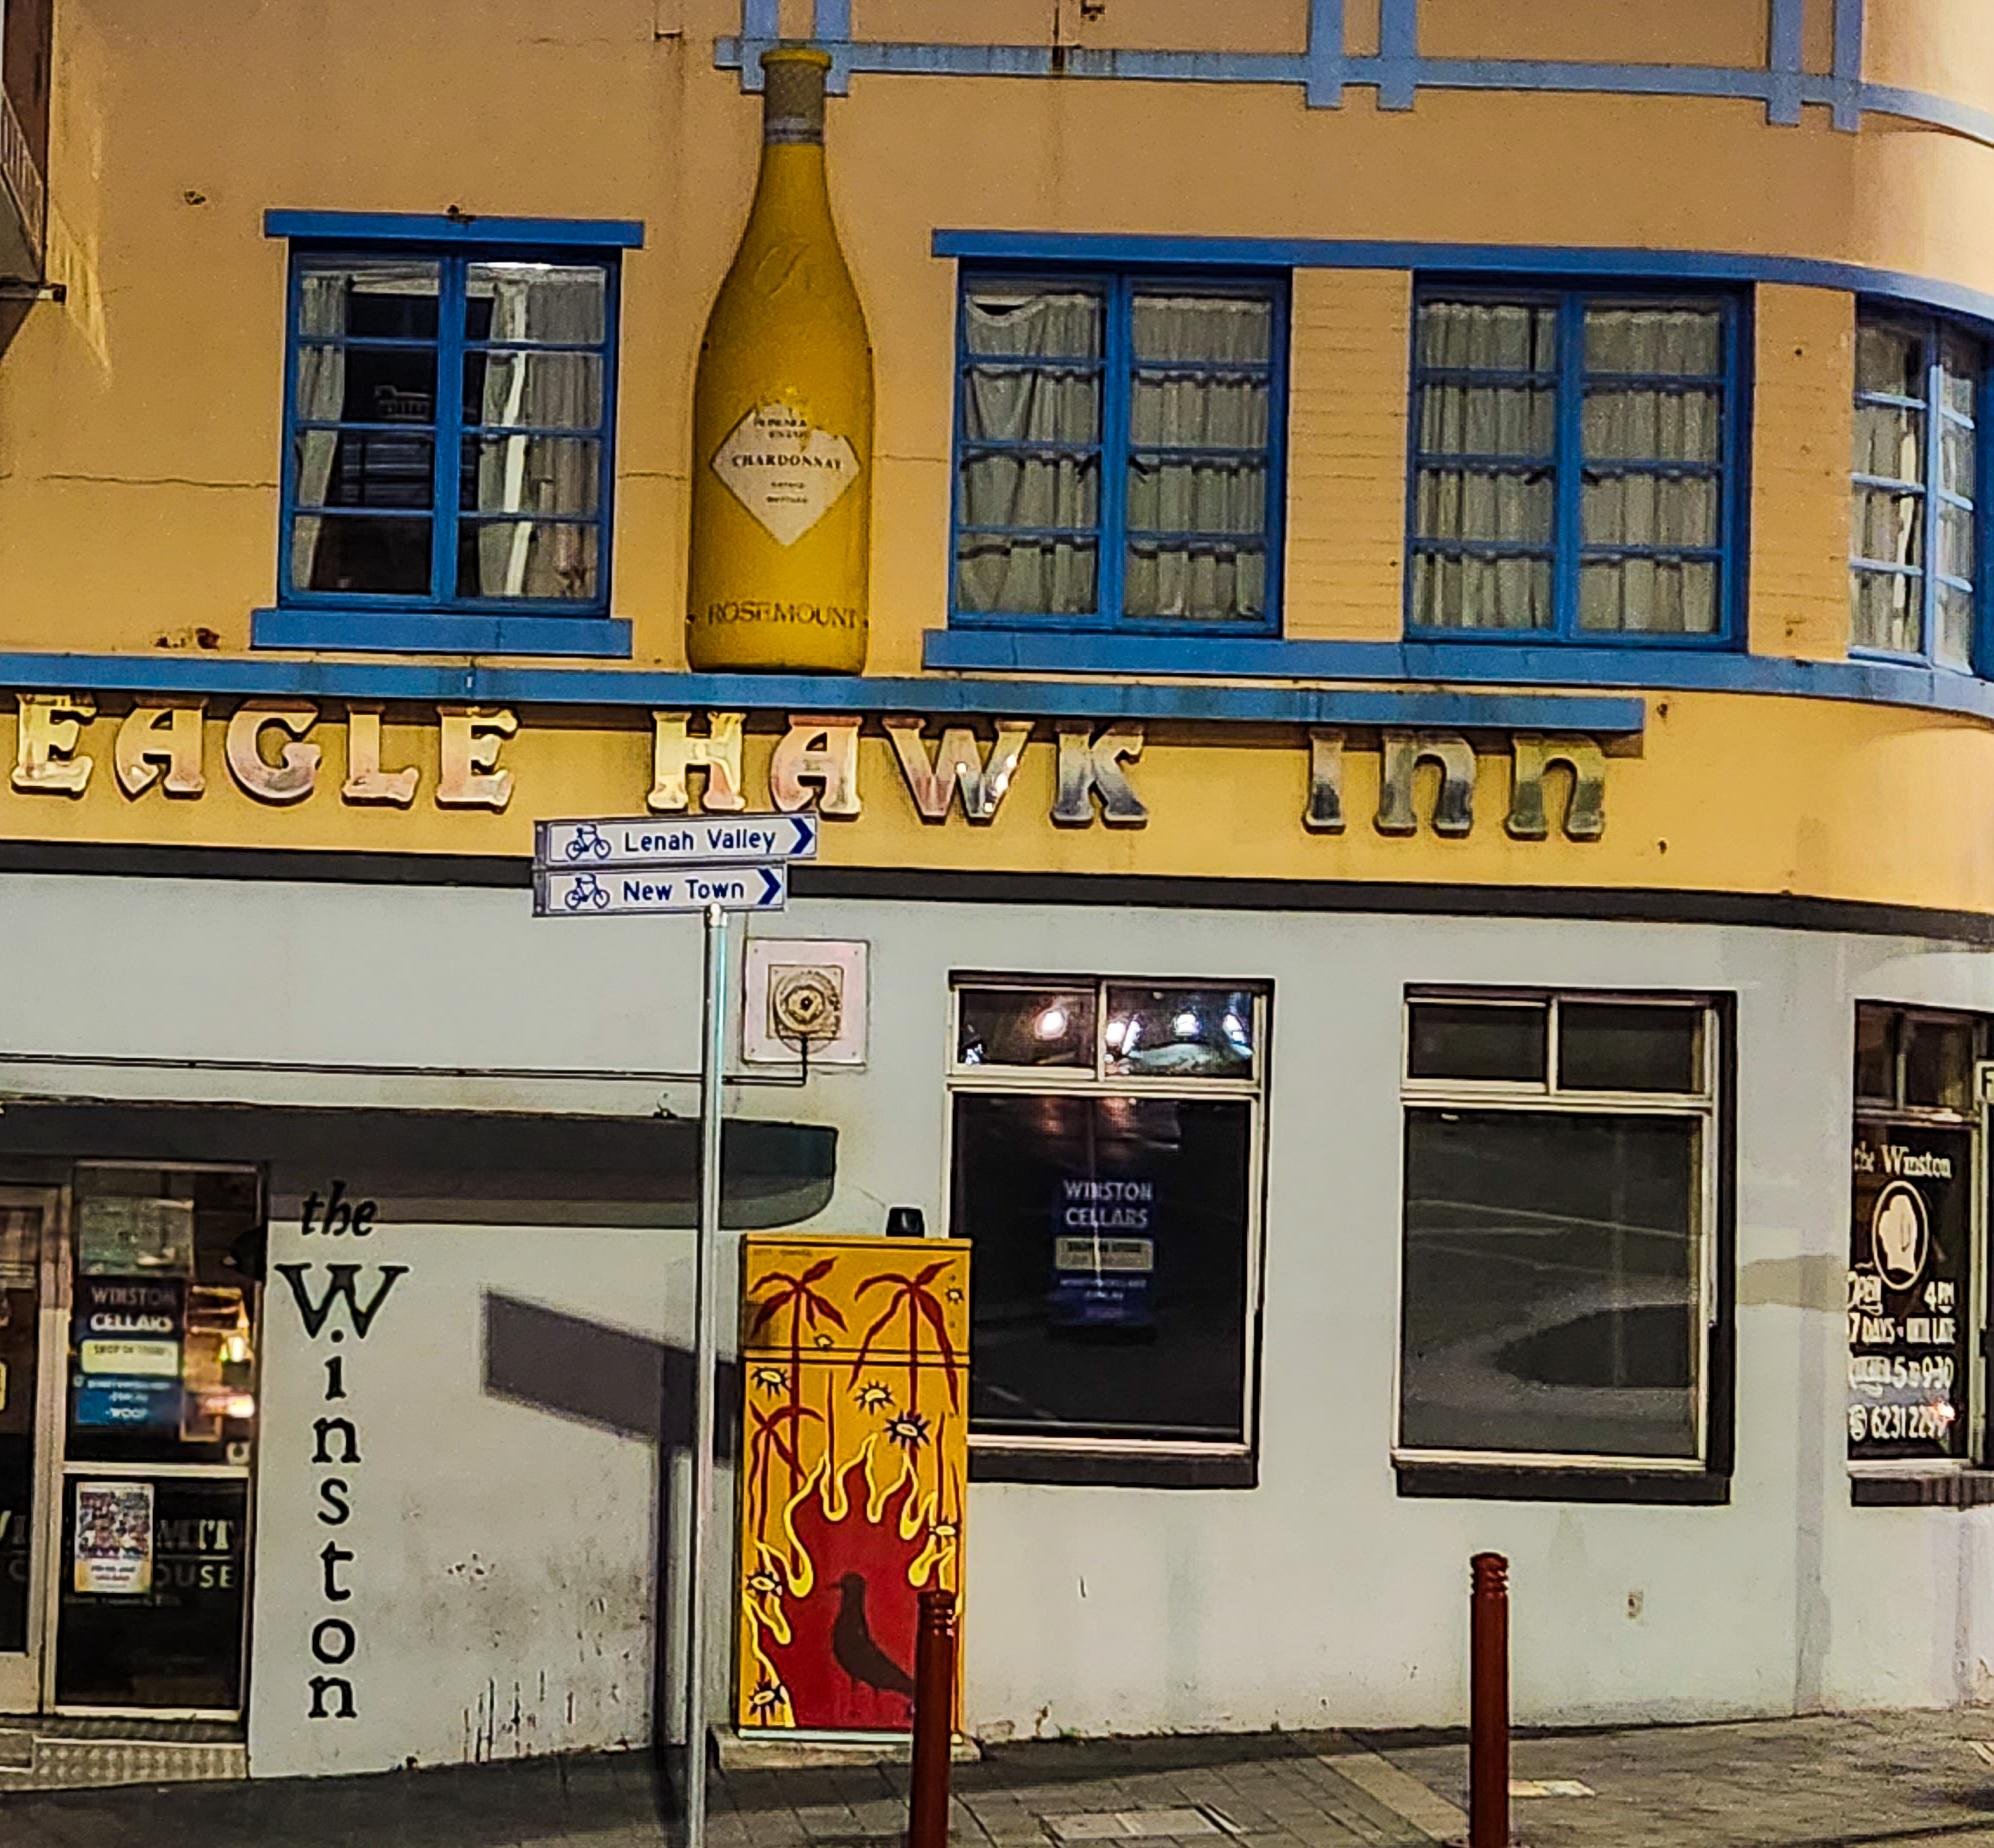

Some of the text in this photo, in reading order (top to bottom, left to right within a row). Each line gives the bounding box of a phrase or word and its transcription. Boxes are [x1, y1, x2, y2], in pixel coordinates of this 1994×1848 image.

[732, 454, 842, 470] CHARDONNAY
[708, 601, 857, 628] ROSEMOUNT
[10, 692, 521, 807] EAGLE
[647, 709, 1148, 831] HAWK
[625, 829, 776, 854] Lenah Valley
[623, 879, 744, 902] New Town
[1881, 1145, 1952, 1178] Winston
[1063, 1180, 1153, 1200] WINSTON
[301, 1180, 376, 1237] the
[1065, 1207, 1149, 1227] CELLARS
[92, 1287, 177, 1306] WINSTON
[90, 1313, 173, 1333] CELLARS
[274, 1263, 410, 1718] Winston
